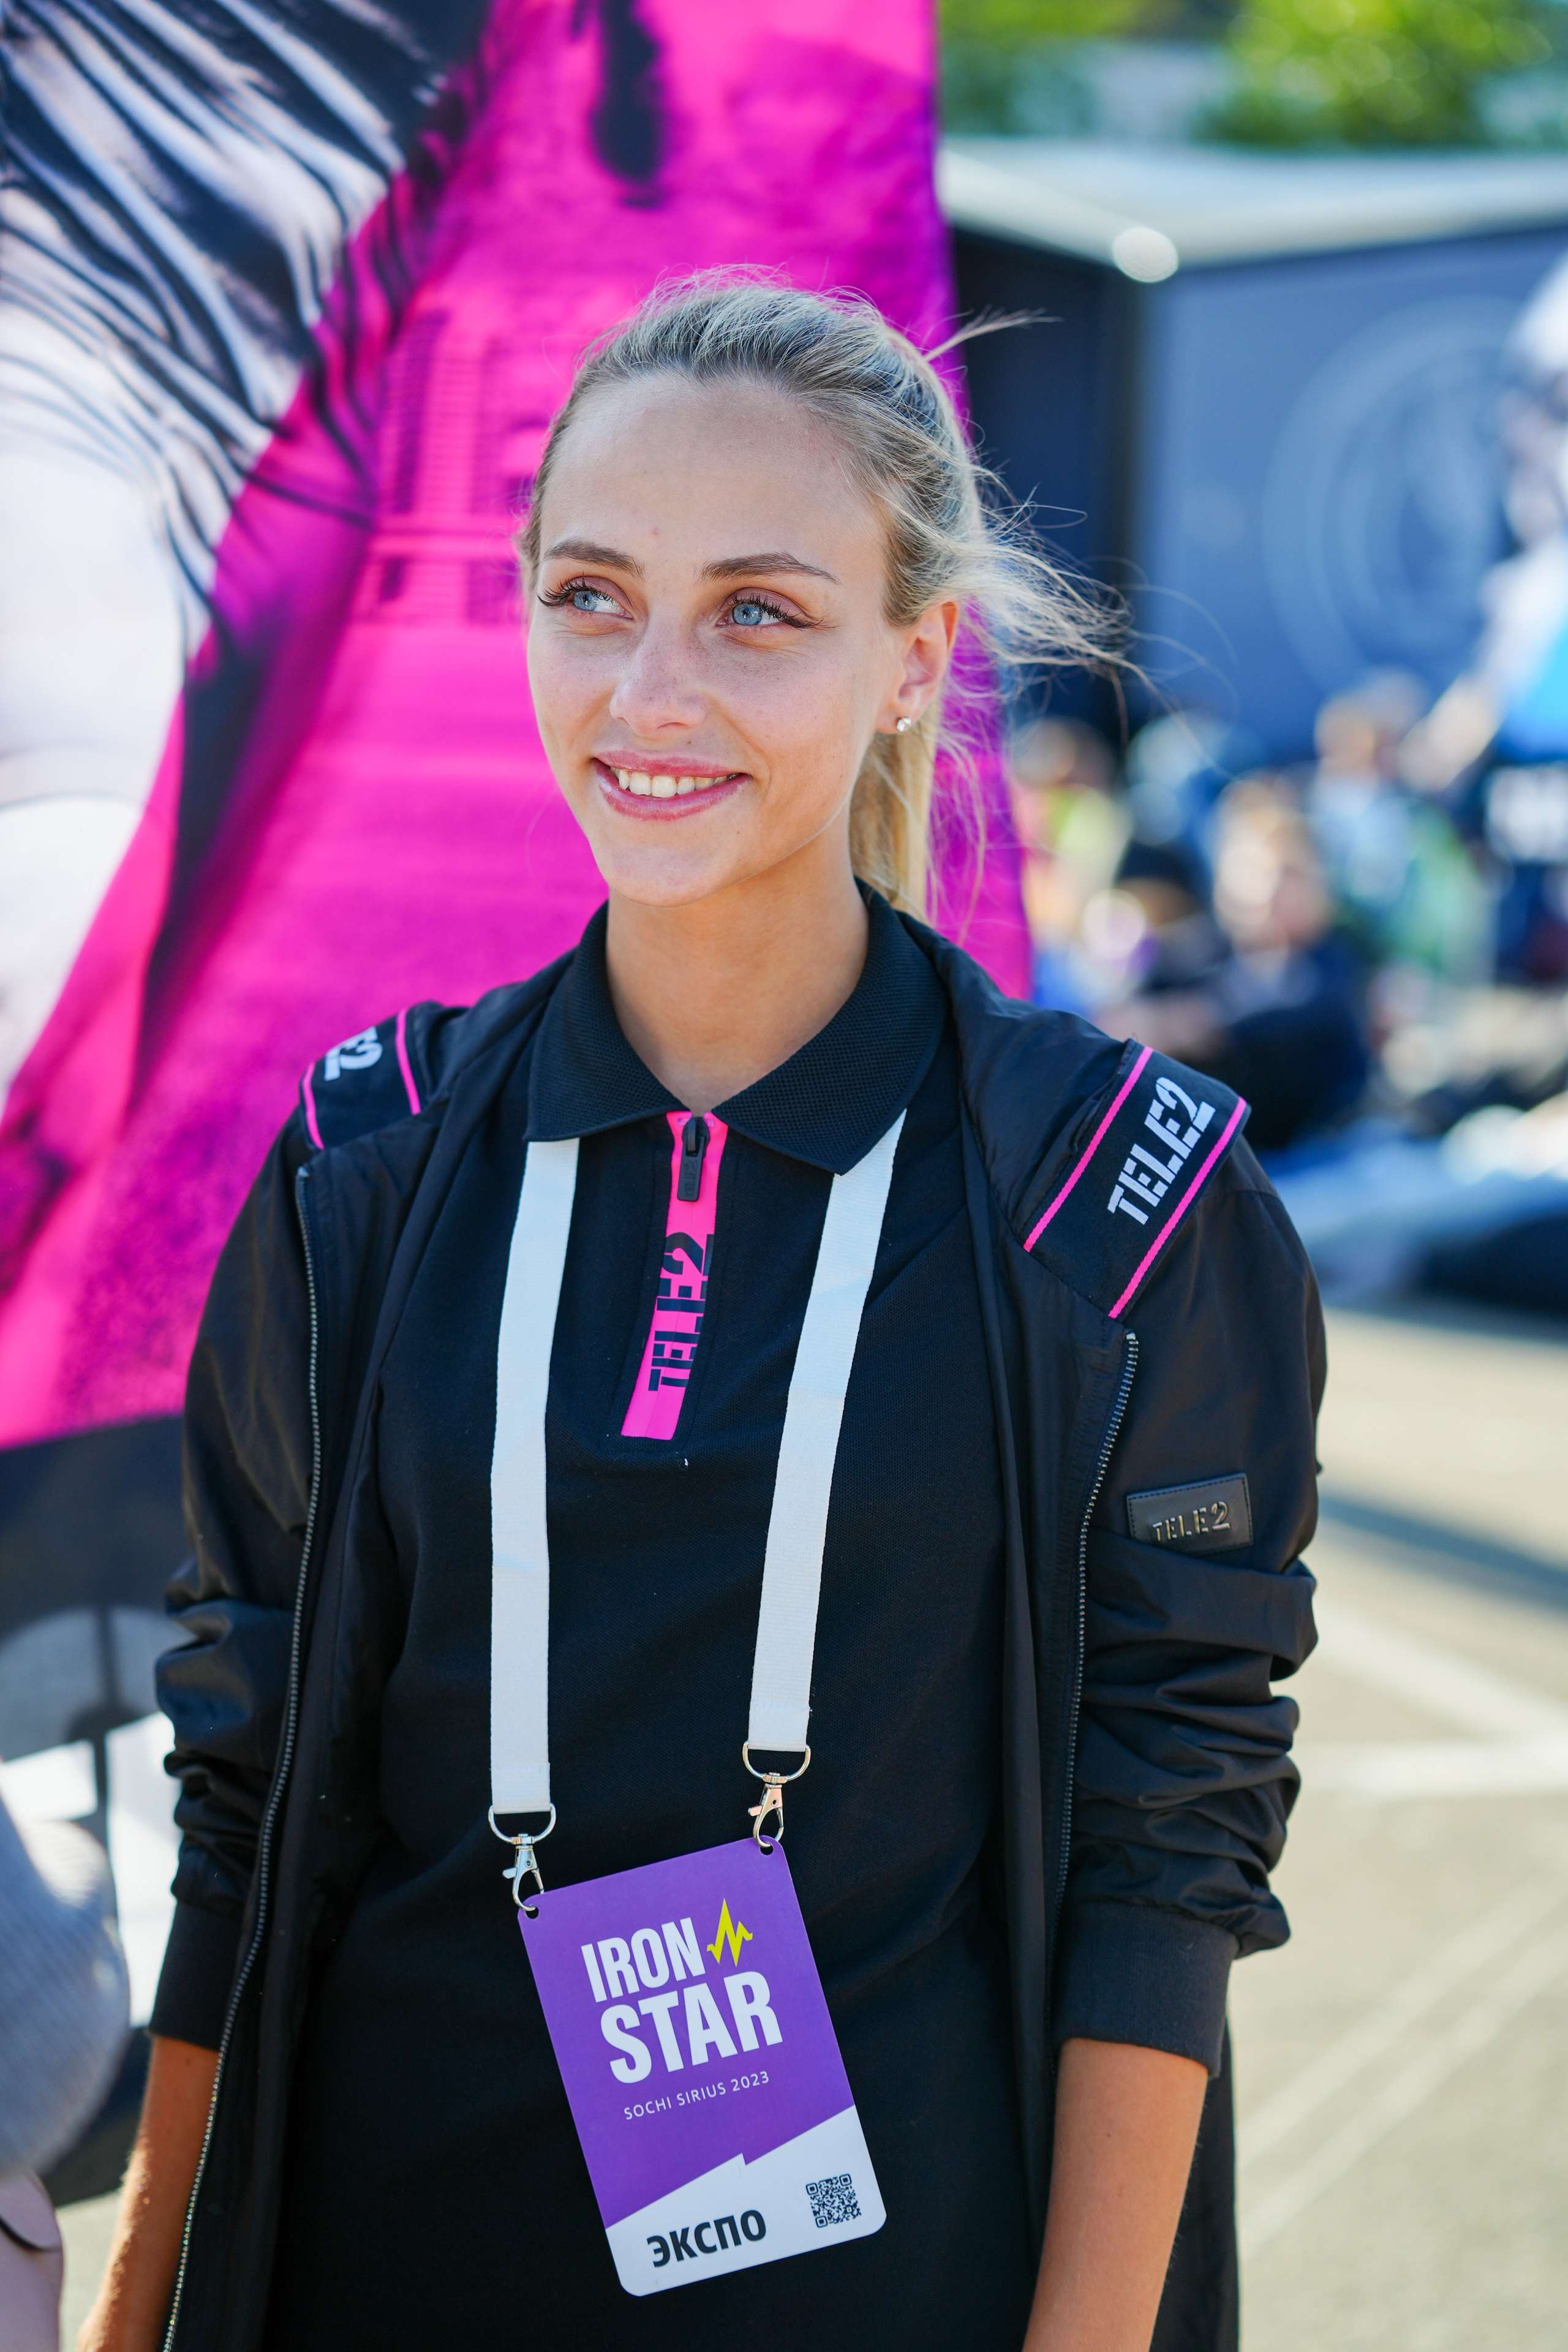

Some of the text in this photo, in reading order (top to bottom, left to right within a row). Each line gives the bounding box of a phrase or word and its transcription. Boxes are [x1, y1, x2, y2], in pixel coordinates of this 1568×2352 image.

[1107, 1077, 1215, 1225] TELE2
[648, 1232, 714, 1392] TELE2
[1152, 1501, 1231, 1541] TELE2
[581, 1917, 706, 2003] IRON
[600, 1971, 783, 2084] STAR
[624, 2071, 769, 2120] SOCHI SIRIUS 2023
[647, 2210, 766, 2267] ЭКСПО
